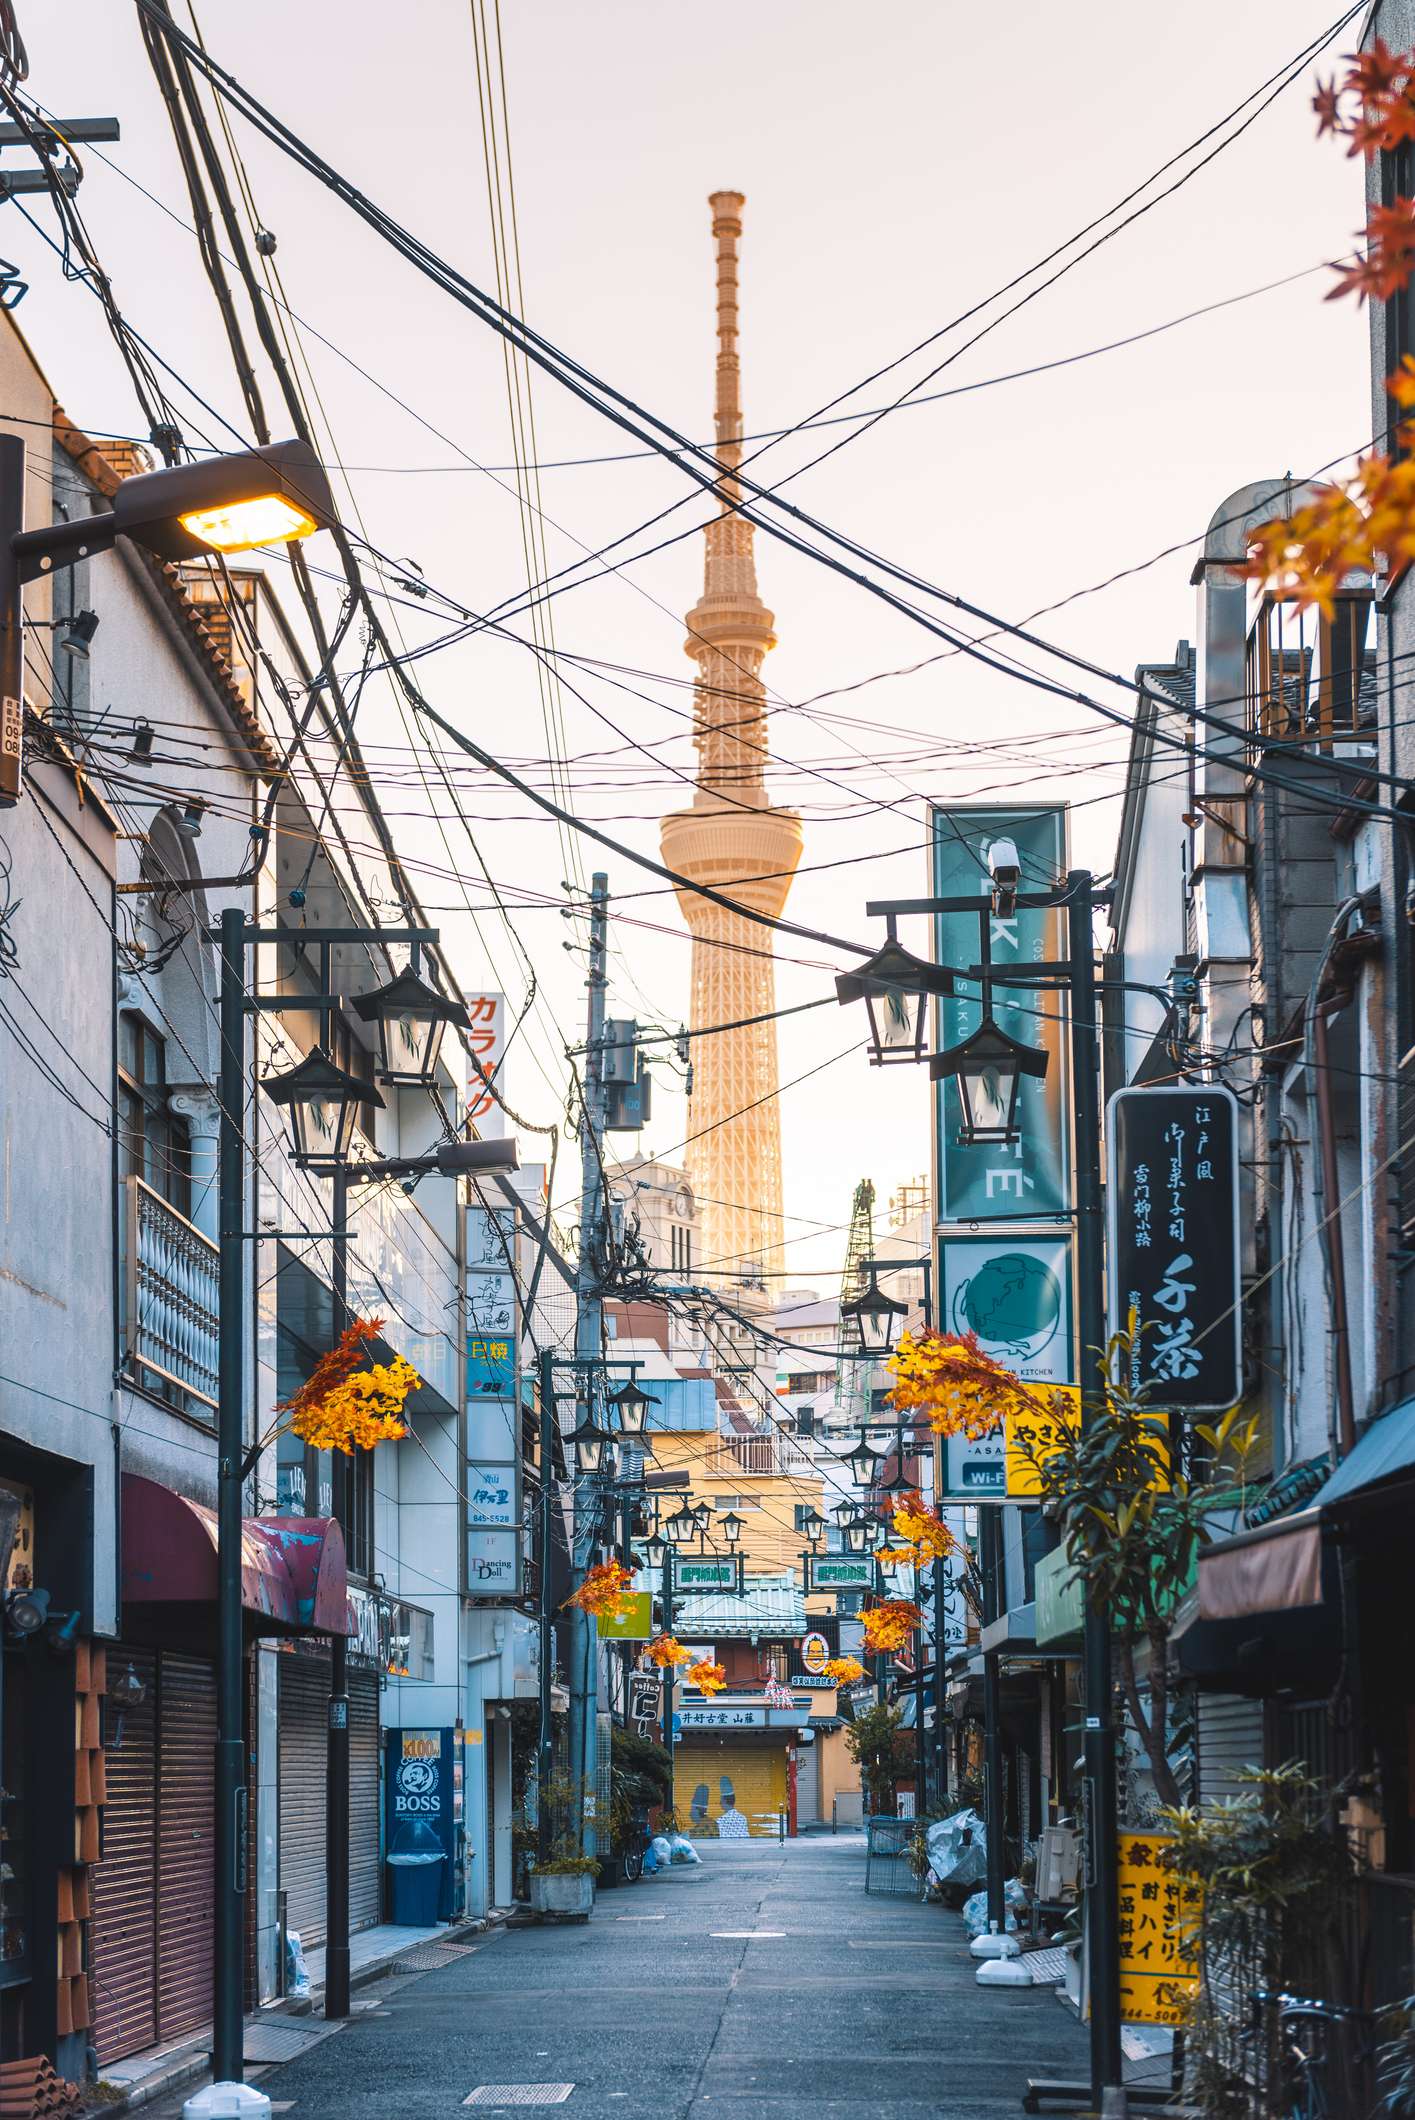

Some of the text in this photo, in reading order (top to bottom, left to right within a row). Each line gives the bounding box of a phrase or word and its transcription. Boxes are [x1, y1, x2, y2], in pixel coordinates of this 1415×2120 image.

[467, 996, 497, 1118] カラオケ
[625, 1100, 640, 1111] 100
[1133, 1164, 1152, 1247] 雷門柳小路
[472, 1341, 508, 1360] 日焼
[1020, 1368, 1053, 1376] KITCHEN
[472, 1489, 509, 1505] 伊万里
[471, 1558, 512, 1572] Dancing
[478, 1565, 502, 1580] Doll
[395, 1796, 441, 1811] BOSS
[1137, 1881, 1160, 1960] 酎ハイ
